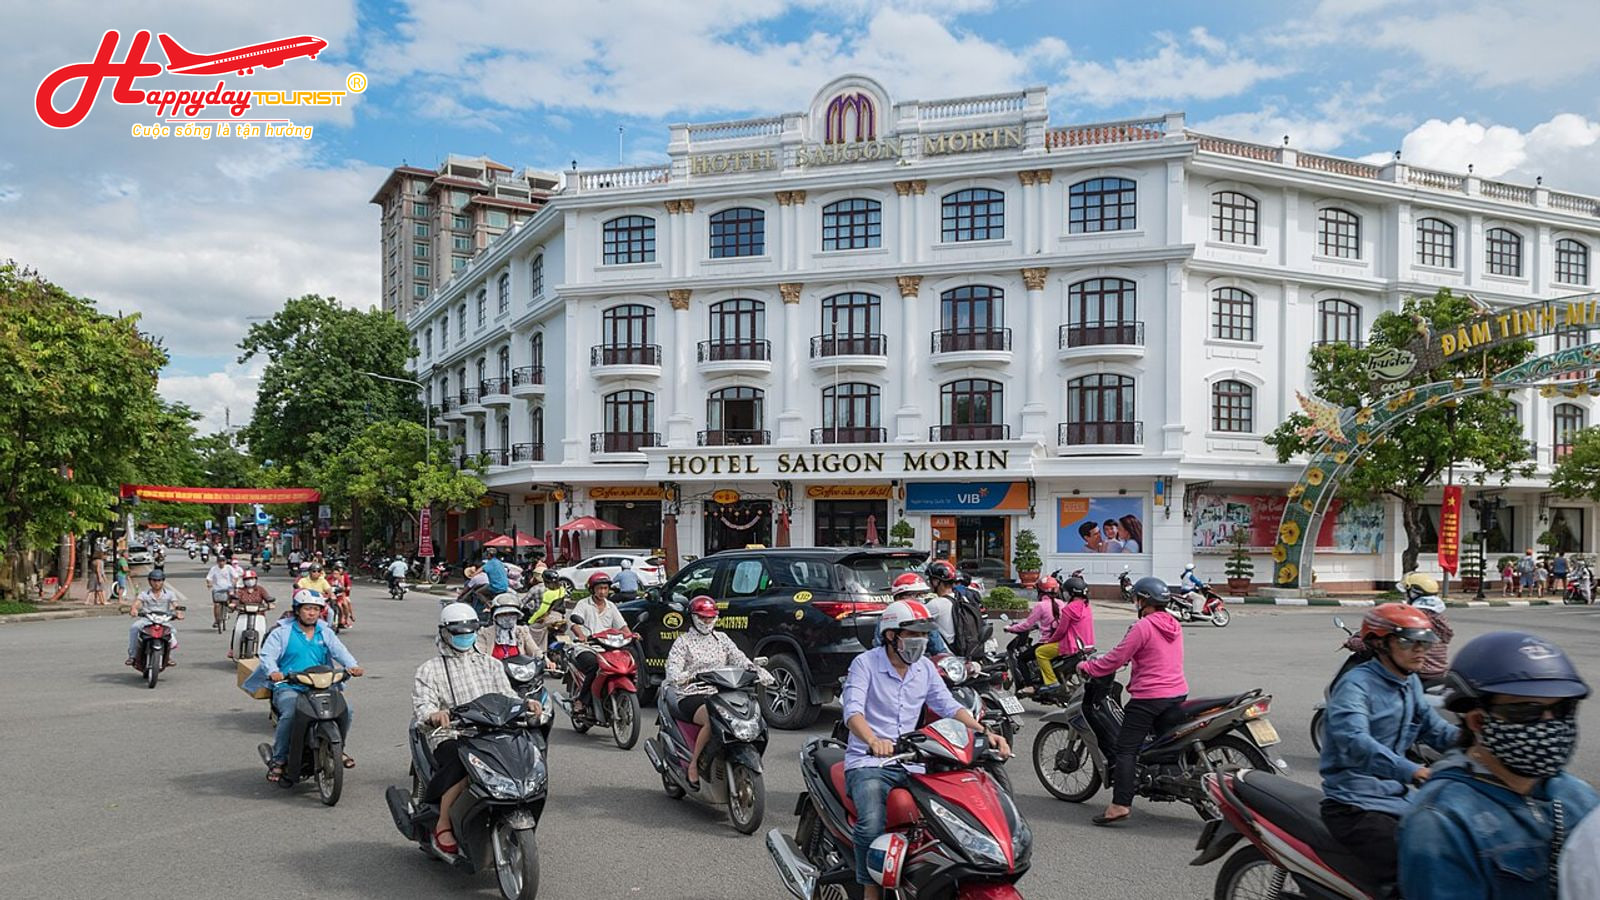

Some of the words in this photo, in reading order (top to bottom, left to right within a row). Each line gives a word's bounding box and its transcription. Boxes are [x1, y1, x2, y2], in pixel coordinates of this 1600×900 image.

[690, 150, 777, 175] HOTEL
[796, 138, 904, 167] SAIGON
[923, 126, 1026, 155] MORIN
[1497, 303, 1557, 338] TÌNH
[668, 455, 759, 474] HOTEL
[777, 452, 885, 473] SAIGON
[904, 449, 1009, 471] MORIN
[957, 493, 980, 504] VIB
